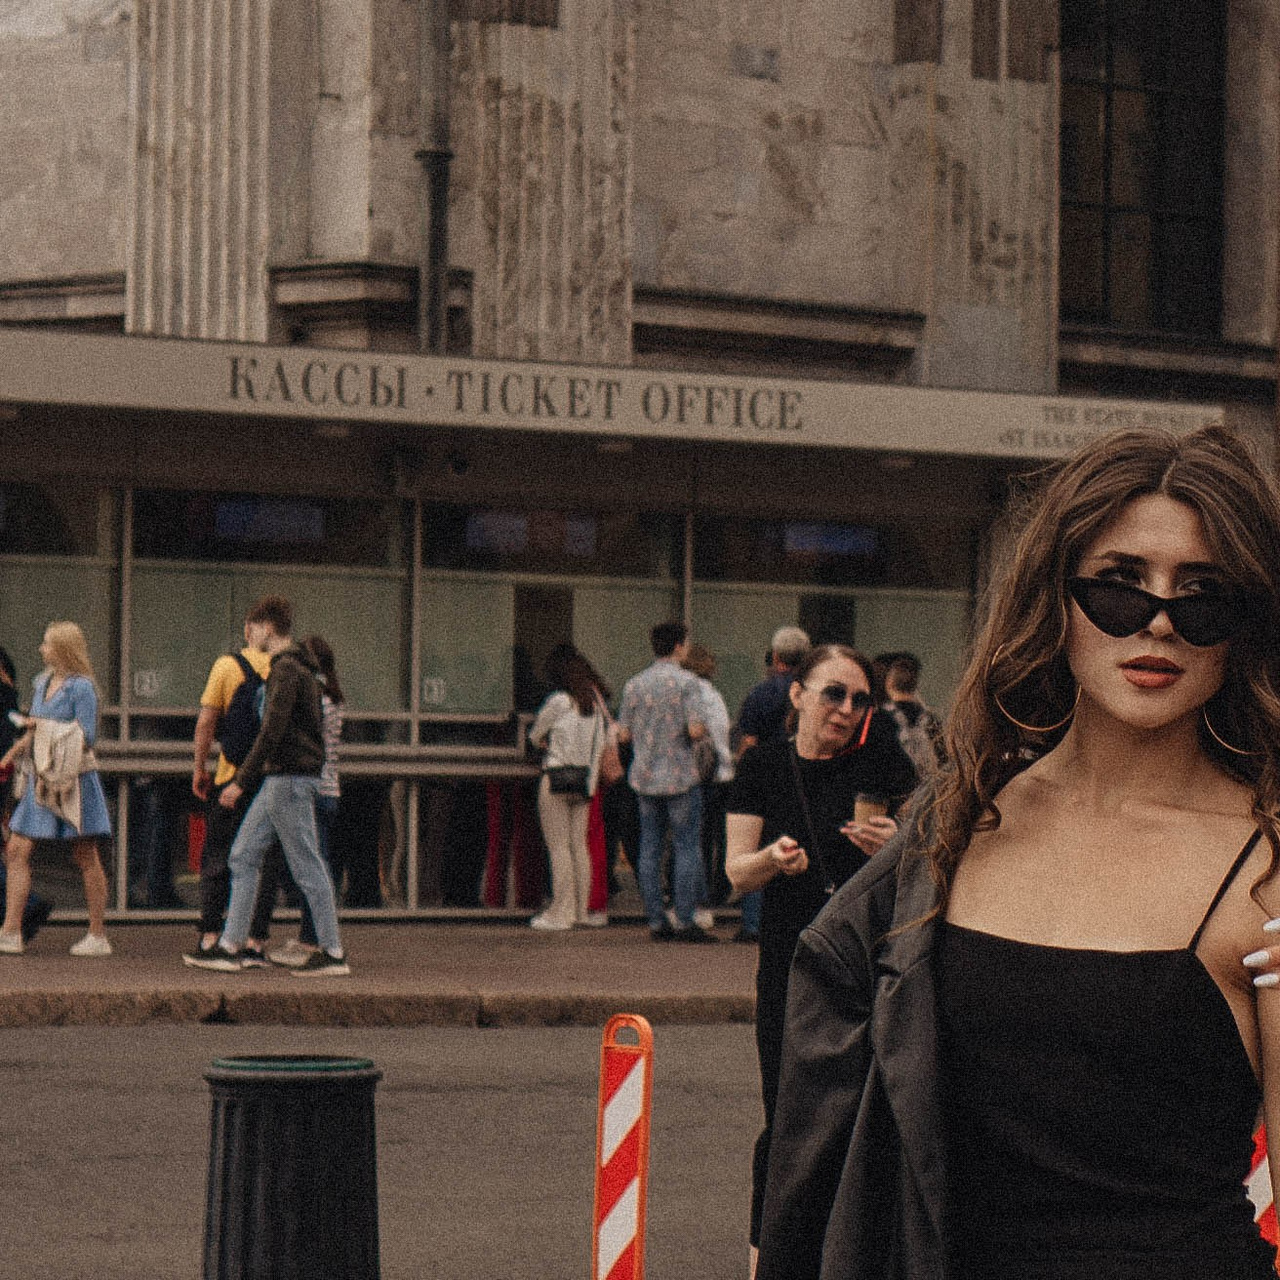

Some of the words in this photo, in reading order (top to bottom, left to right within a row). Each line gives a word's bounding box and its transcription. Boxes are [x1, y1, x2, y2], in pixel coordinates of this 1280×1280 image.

[228, 355, 408, 409] КАССЫ
[446, 370, 622, 420] TICKET
[641, 381, 803, 431] OFFICE
